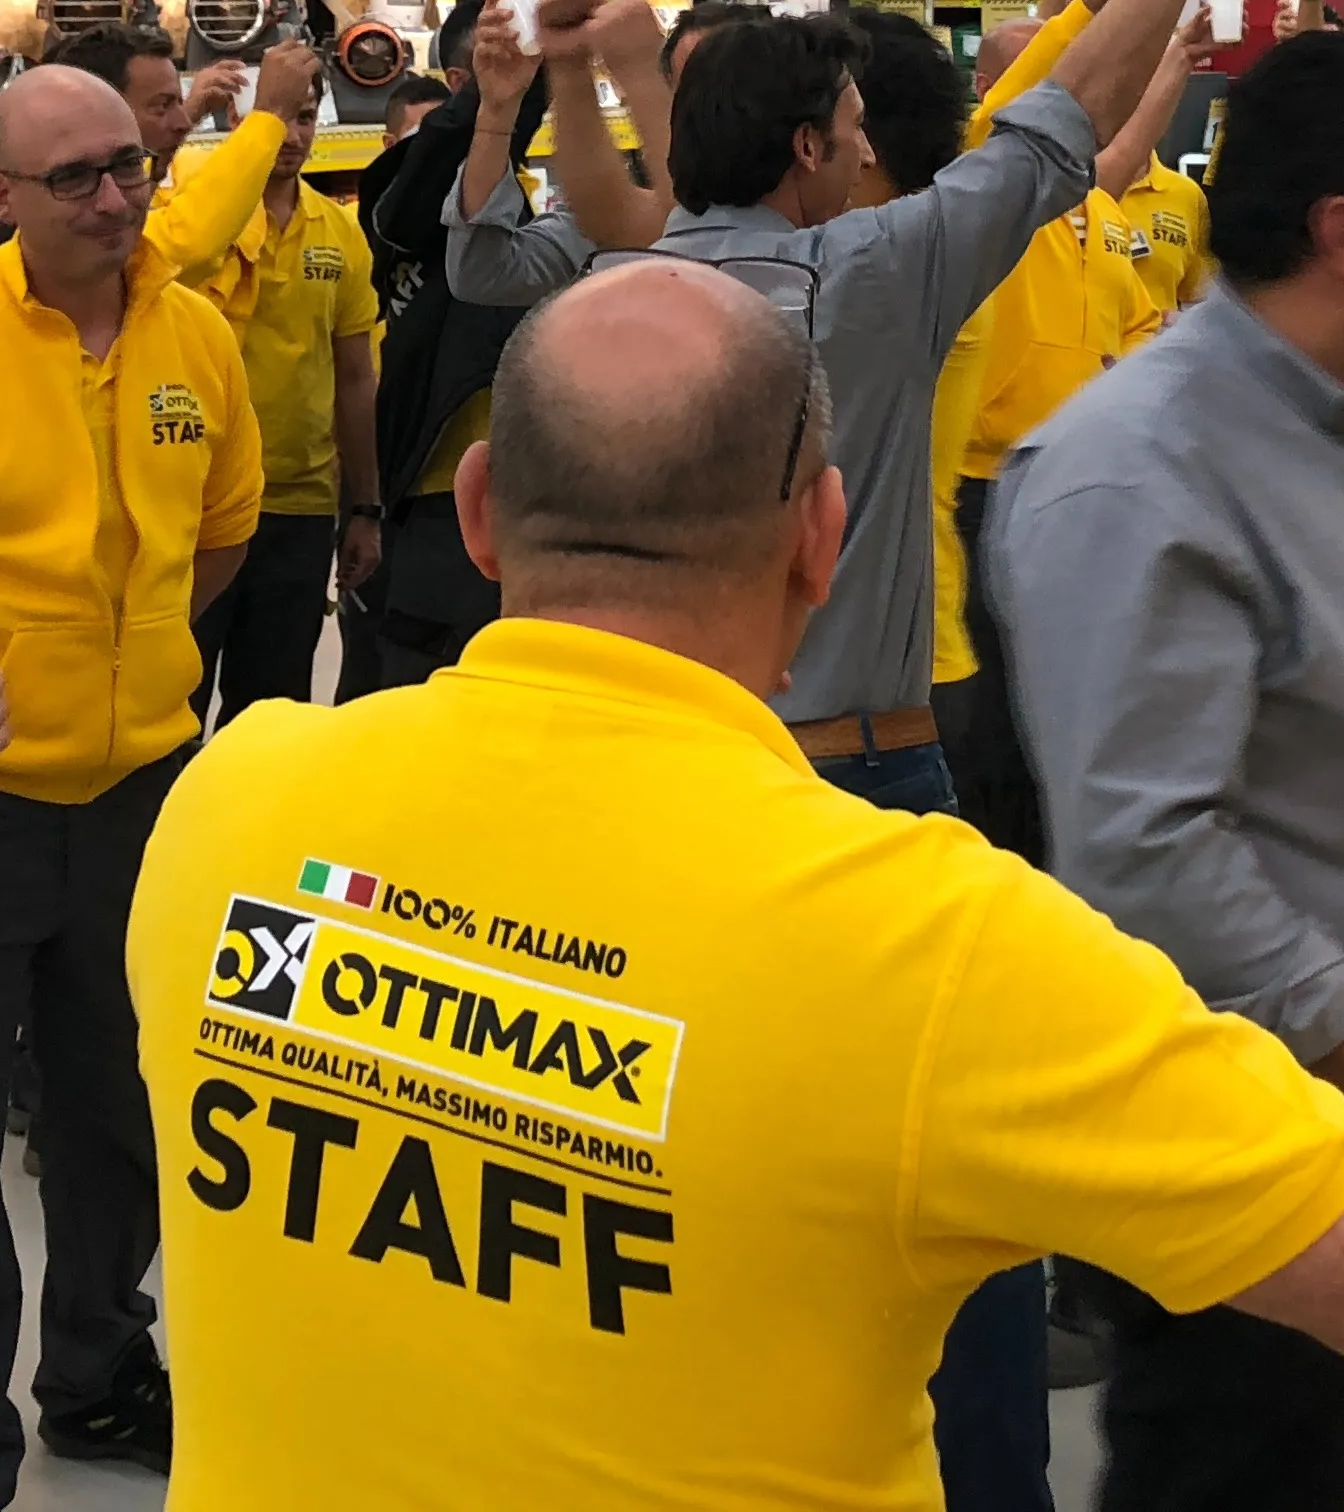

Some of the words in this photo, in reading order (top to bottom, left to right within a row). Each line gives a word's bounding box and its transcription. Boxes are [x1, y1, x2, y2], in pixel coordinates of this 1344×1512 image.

[381, 882, 477, 940] 100%
[487, 915, 627, 979] ITALIANO
[199, 1016, 276, 1062] OTTIMA
[281, 1038, 390, 1098] QUALITÀ,
[395, 1074, 508, 1131] MASSIMO
[514, 1114, 664, 1178] RISPARMIO.
[322, 951, 653, 1106] OTTIMAX
[186, 1077, 674, 1336] STAFF
